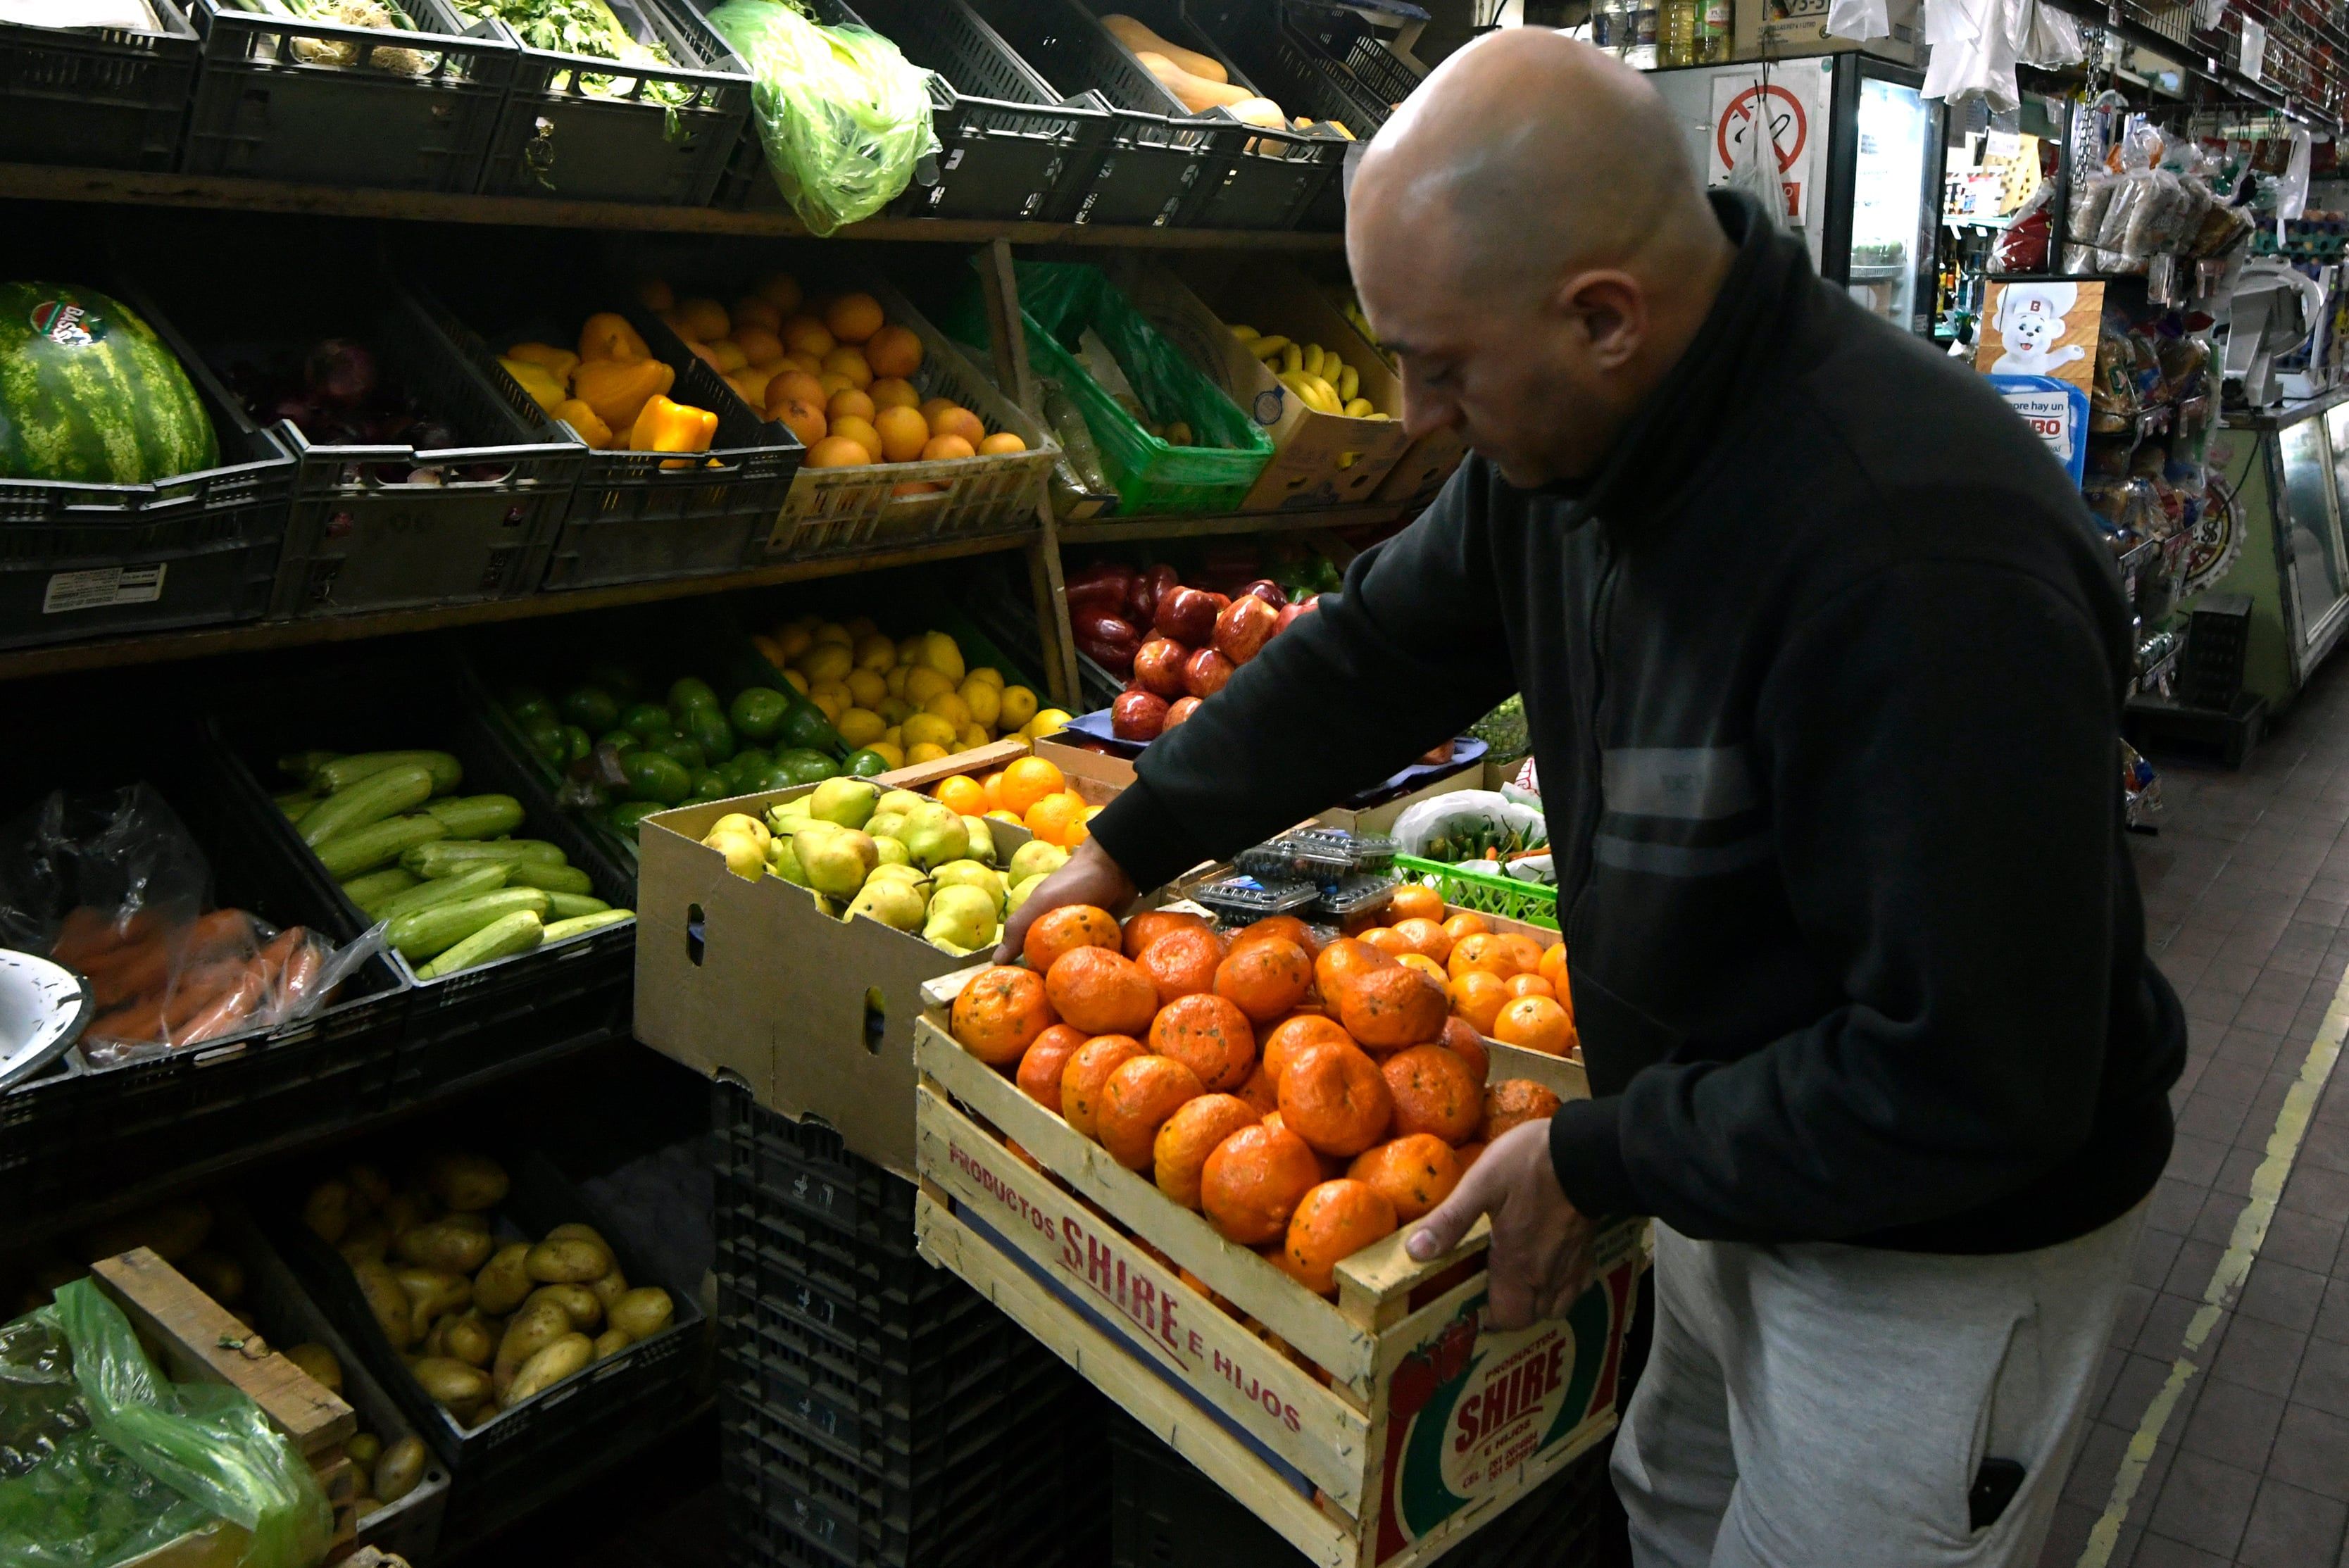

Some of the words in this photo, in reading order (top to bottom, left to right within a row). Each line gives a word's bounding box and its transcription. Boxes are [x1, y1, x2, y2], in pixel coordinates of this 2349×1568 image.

[2030, 300, 2041, 312] B
[2031, 401, 2048, 412] hay
[2030, 419, 2060, 434] BO
[948, 1141, 1056, 1241] PRODUCTOS
[1061, 1216, 1179, 1350] SHIRE
[1188, 1330, 1204, 1359] E
[1214, 1349, 1301, 1432] HIJOS
[1455, 1337, 1566, 1453] SHIRE
